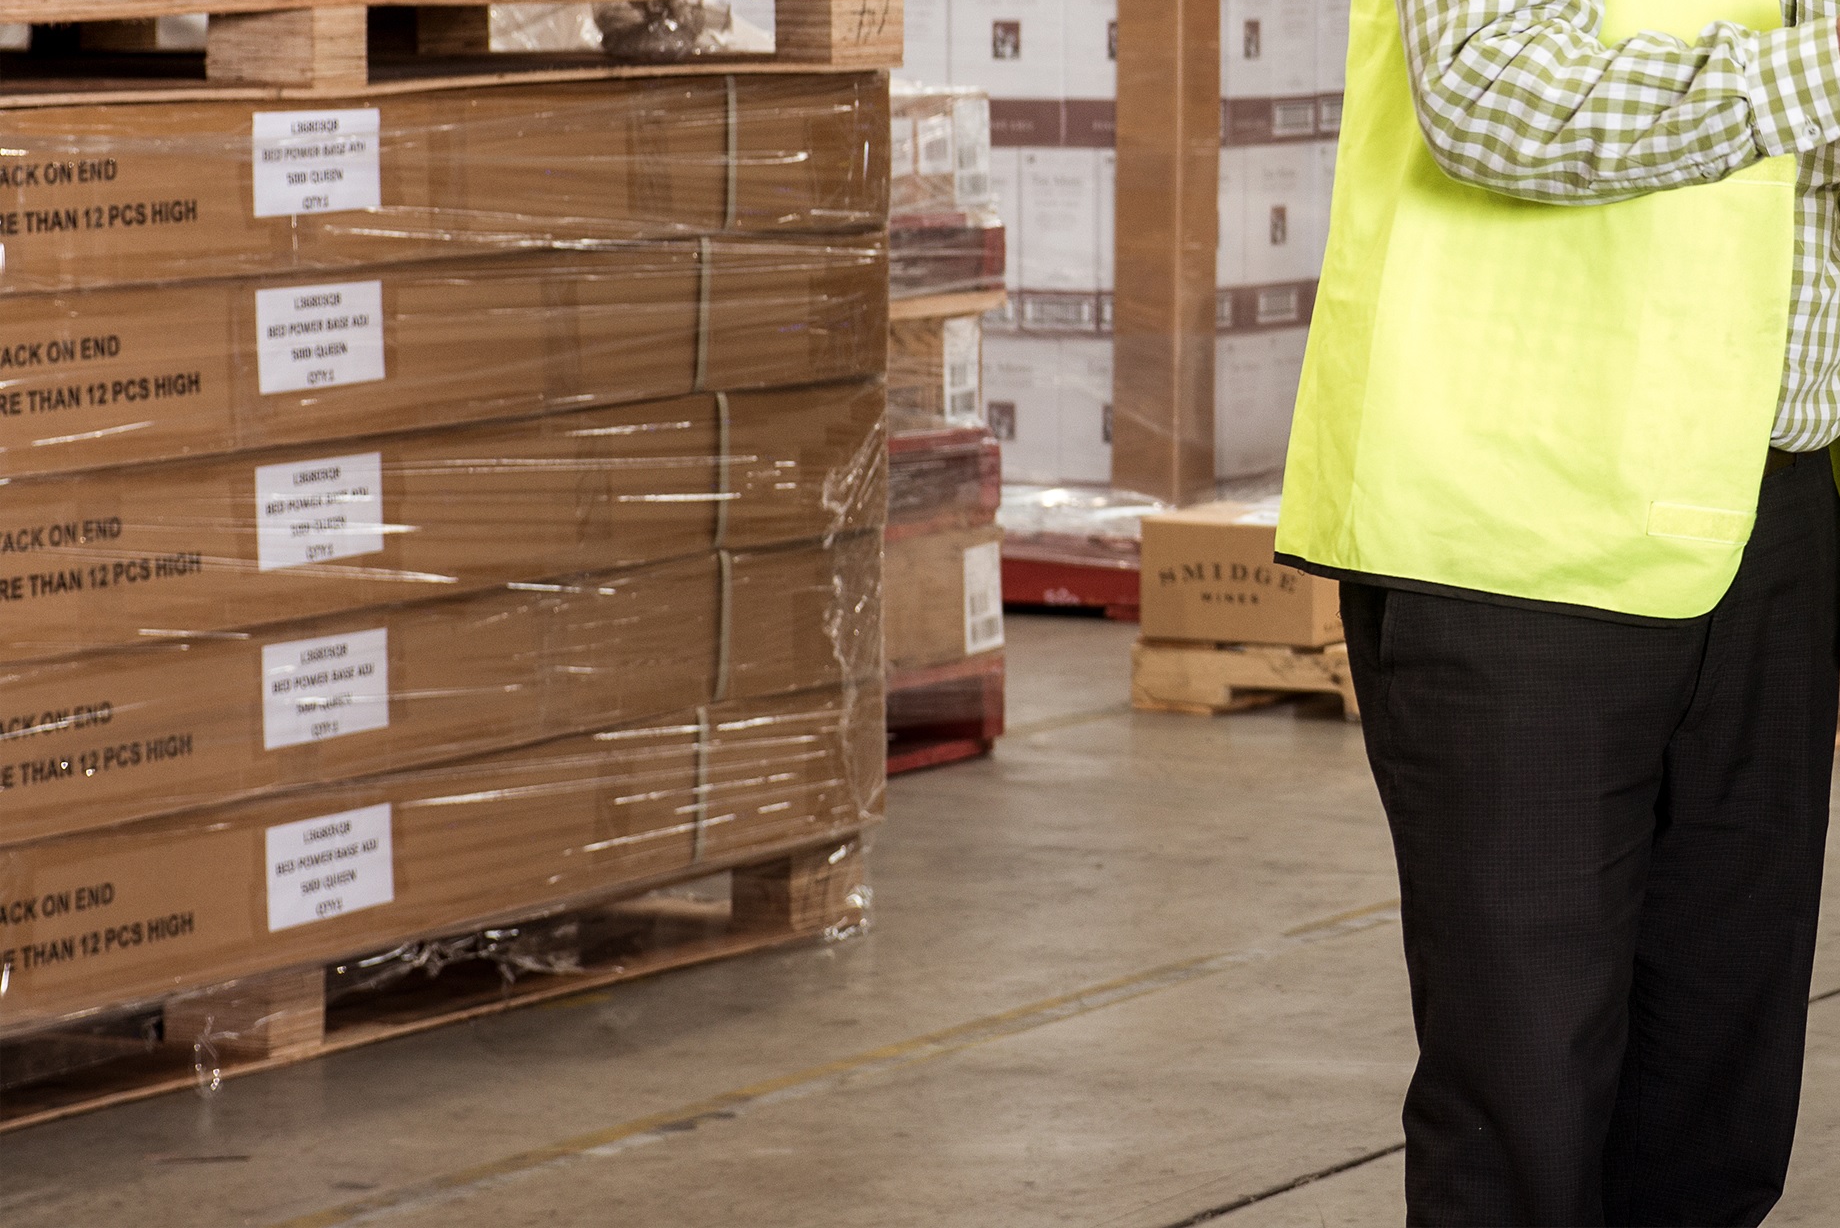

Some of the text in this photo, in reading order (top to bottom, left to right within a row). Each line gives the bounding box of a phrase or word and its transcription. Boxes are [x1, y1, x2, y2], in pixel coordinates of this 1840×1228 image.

[44, 163, 72, 185] ON
[78, 159, 117, 183] END
[25, 207, 78, 233] THAN
[84, 206, 104, 229] 12
[109, 203, 147, 227] PCS
[151, 199, 196, 223] HIGH
[47, 339, 75, 363] ON
[81, 335, 120, 360] END
[28, 386, 80, 412] THAN
[88, 382, 107, 406] 12
[112, 378, 149, 403] PCS
[154, 372, 200, 398] HIGH
[49, 524, 77, 547] ON
[83, 517, 122, 542] END
[28, 569, 82, 597] THAN
[90, 564, 107, 589] 12
[113, 558, 150, 585] PCS
[156, 552, 201, 578] HIGH
[1158, 563, 1298, 594] SMIDGE
[41, 708, 70, 733] ON
[74, 701, 113, 729] END
[20, 755, 73, 785] THAN
[80, 749, 99, 776] 12
[104, 742, 141, 771] PCS
[146, 733, 193, 761] HIGH
[42, 891, 70, 918] ON
[75, 882, 114, 911] END
[21, 935, 75, 970] THAN
[80, 931, 100, 956] 12
[105, 922, 143, 953] PCS
[147, 912, 194, 943] HIGH
